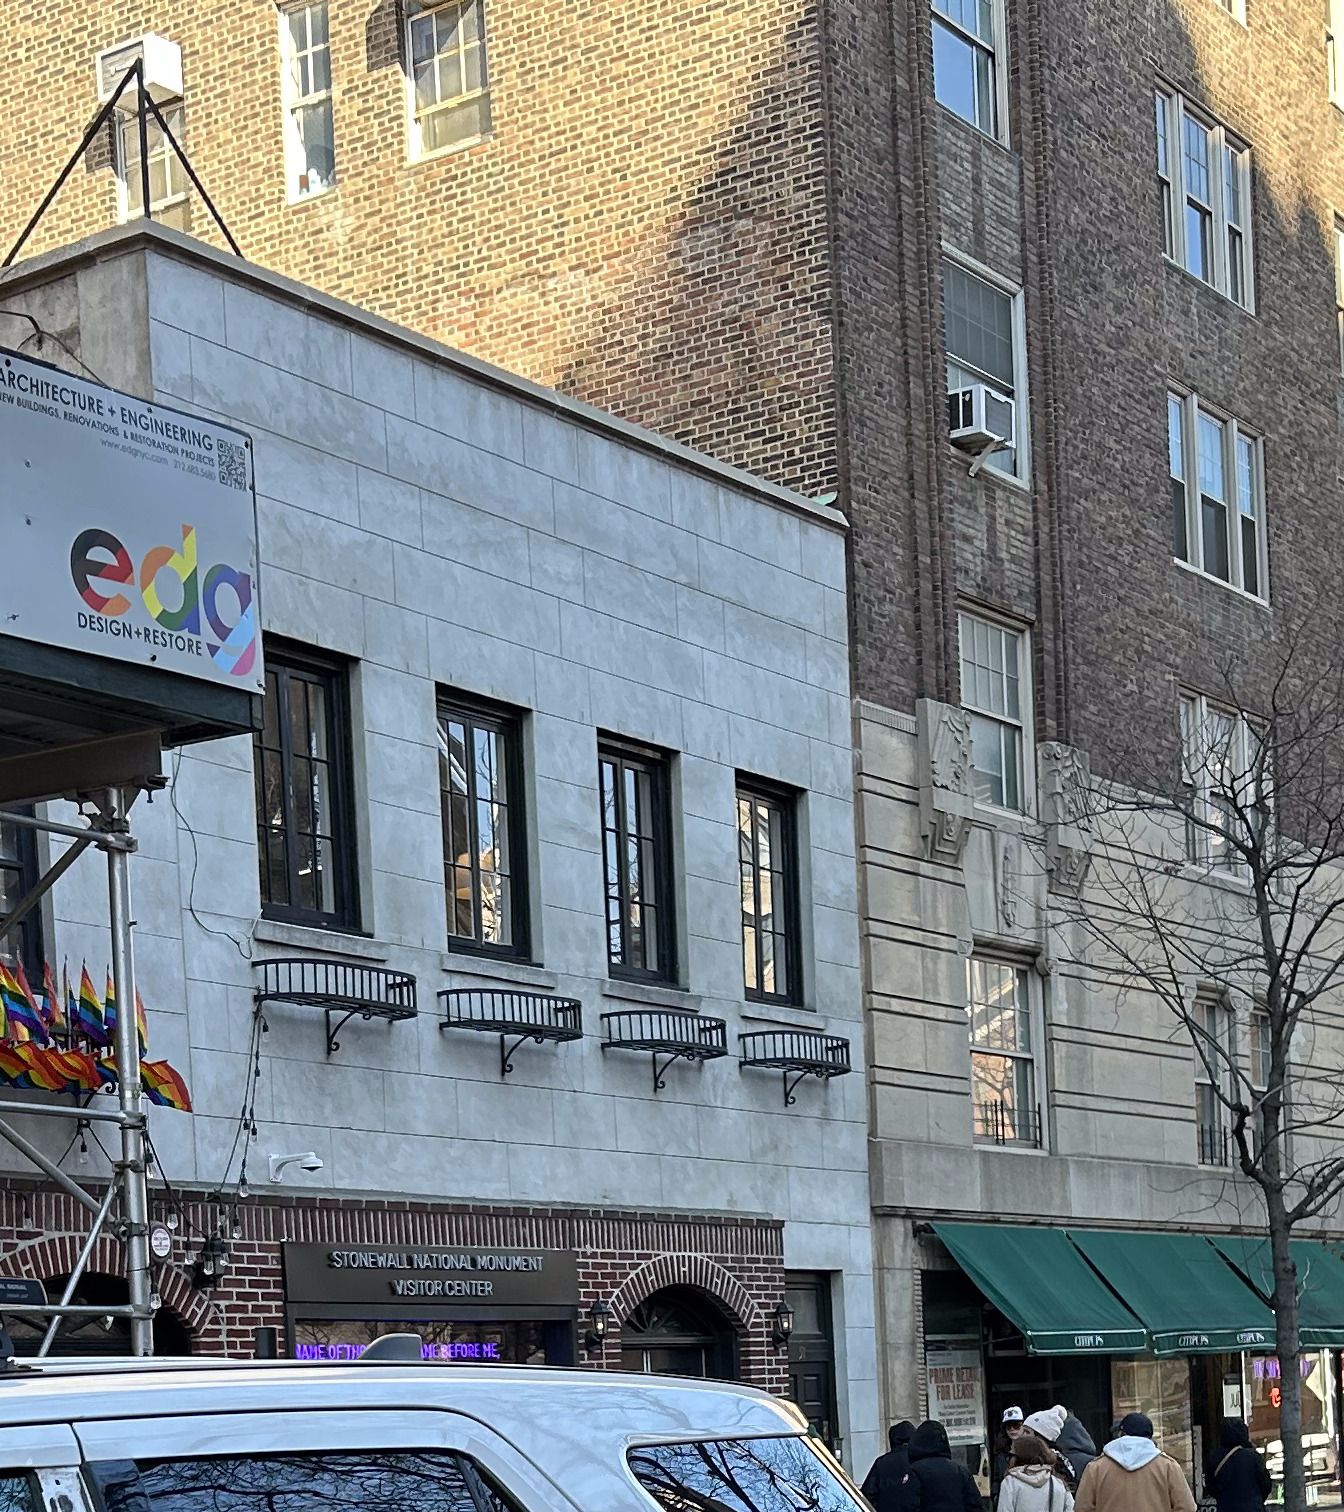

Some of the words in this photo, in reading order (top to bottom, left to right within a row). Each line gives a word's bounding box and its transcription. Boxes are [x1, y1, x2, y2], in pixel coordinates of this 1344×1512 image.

[63, 410, 120, 437] RENOVATIONS
[180, 447, 216, 468] PROJECTS
[119, 406, 213, 451] ENGINEERING
[76, 611, 203, 657] DESIGN+RESTORE
[330, 1251, 410, 1270] STONEWALL
[412, 1253, 476, 1271] NATIONAL
[477, 1255, 544, 1272] MONUMENT
[392, 1279, 444, 1297] VISITOR
[444, 1280, 494, 1297] CENTER
[440, 1342, 478, 1360] BEFORE
[952, 1382, 976, 1400] LEASE
